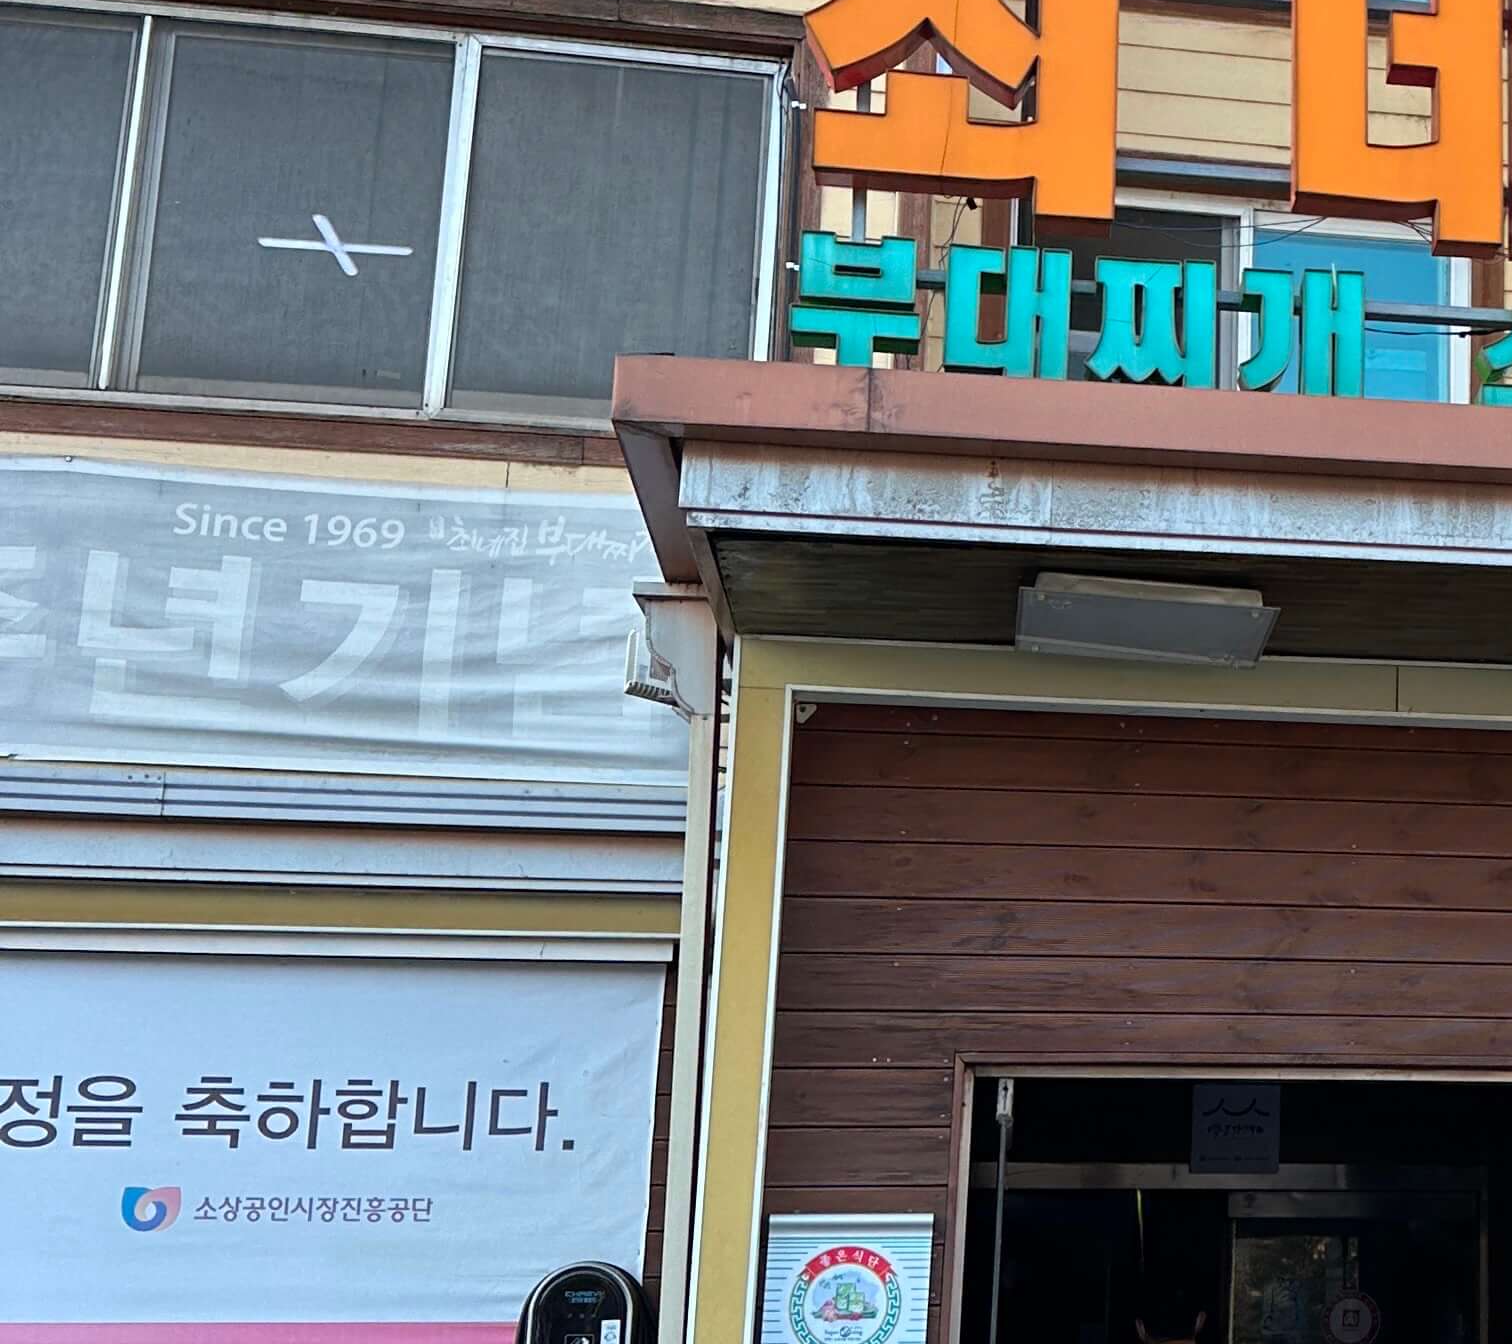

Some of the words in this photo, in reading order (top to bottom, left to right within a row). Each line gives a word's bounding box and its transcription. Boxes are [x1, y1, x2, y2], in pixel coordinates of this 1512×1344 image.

[790, 229, 1365, 398] 부대찌개
[174, 503, 287, 544] Since
[303, 512, 406, 550] 1969
[0, 1074, 144, 1148] 정을
[174, 1075, 575, 1152] 축하합니다.
[193, 1195, 433, 1224] 소상공인시장진흥공단
